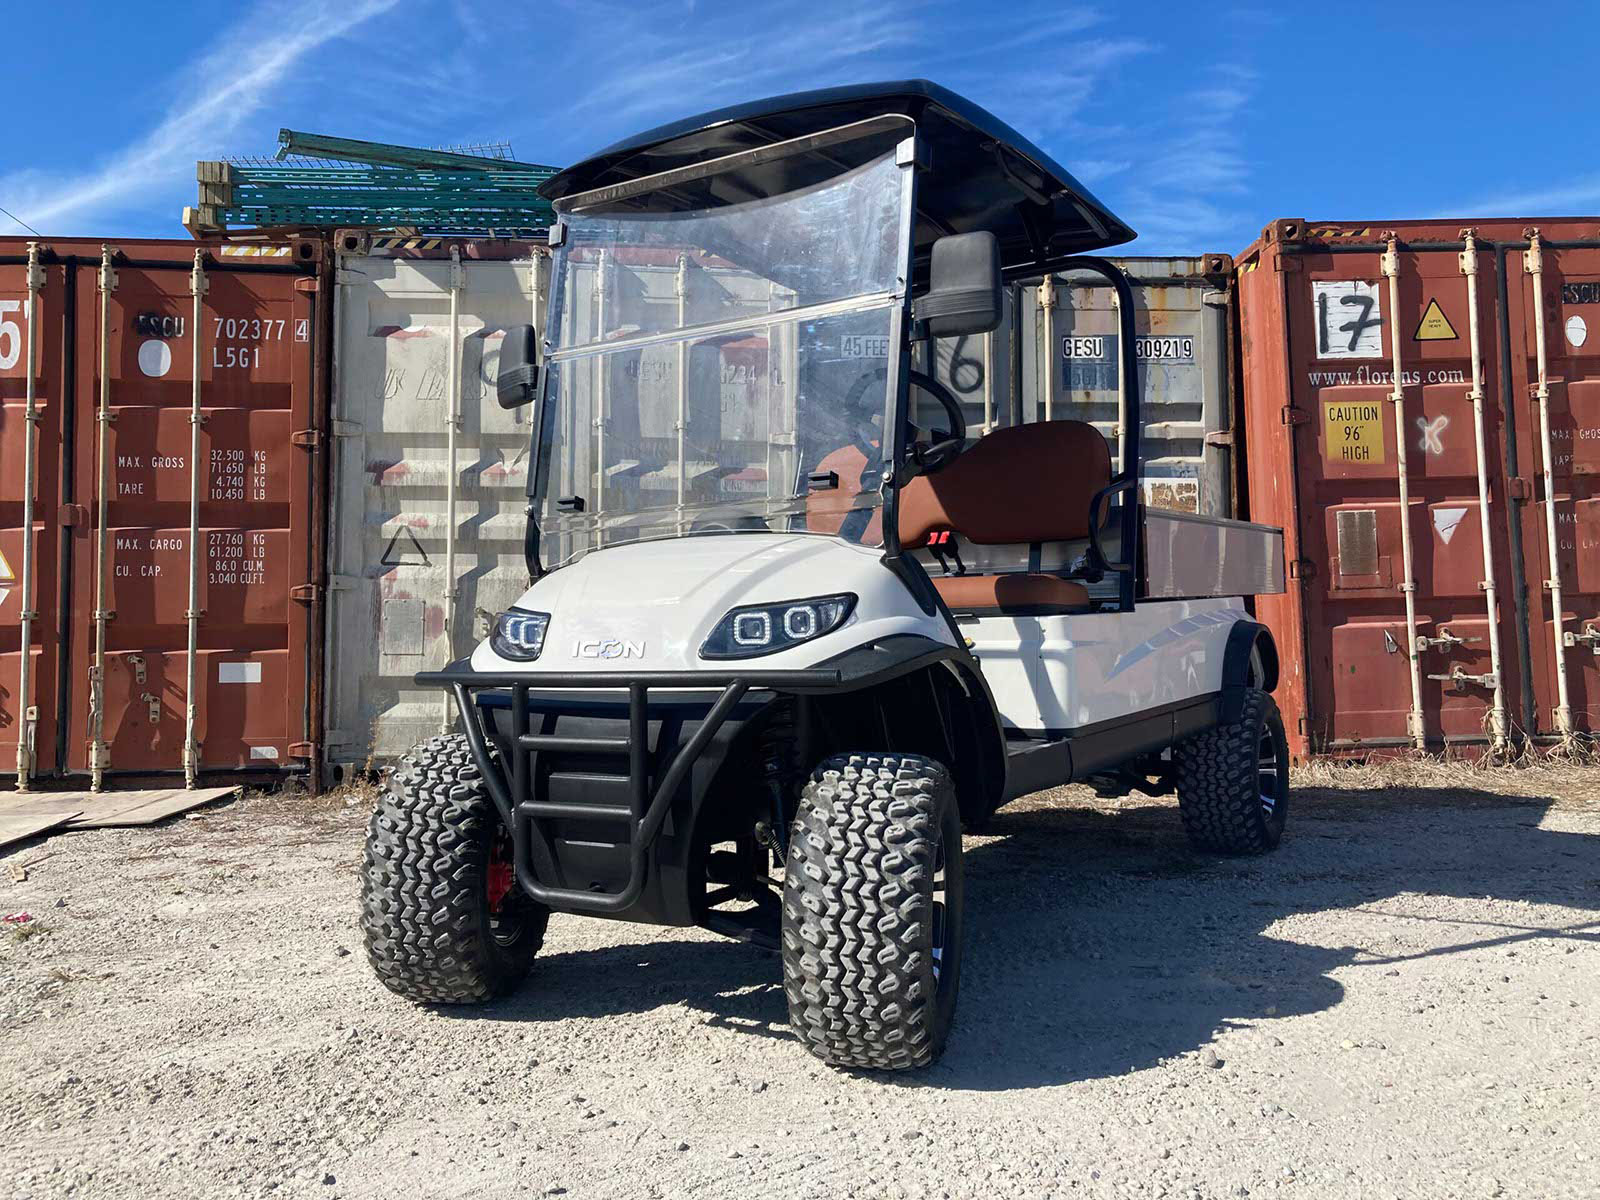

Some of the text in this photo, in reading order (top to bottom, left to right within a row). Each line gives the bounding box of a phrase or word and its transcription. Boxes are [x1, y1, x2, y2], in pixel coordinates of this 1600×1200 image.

[213, 317, 286, 341] 702377
[295, 318, 309, 342] 4
[1318, 292, 1384, 354] 17
[843, 337, 891, 356] 45 FEE
[1063, 338, 1104, 357] GESU
[213, 347, 259, 369] L5G1
[1329, 406, 1378, 421] CAUTION
[211, 449, 266, 462] 32.500 KG
[1342, 446, 1369, 460] HIGH
[118, 455, 185, 468] MAX. GROSS
[211, 462, 266, 474] 71.650 LB
[118, 482, 144, 494] TARE
[216, 476, 266, 487] 4.740 KG
[211, 488, 266, 500] 10.450 LB
[116, 538, 183, 551] MAX. CARGO
[210, 533, 265, 545] 27.760 KG
[209, 546, 265, 558] 61.200 LB
[116, 565, 163, 577] CU. CAP.
[215, 560, 237, 571] 86.0
[209, 572, 237, 584] 3.040
[572, 639, 646, 660] ICON
